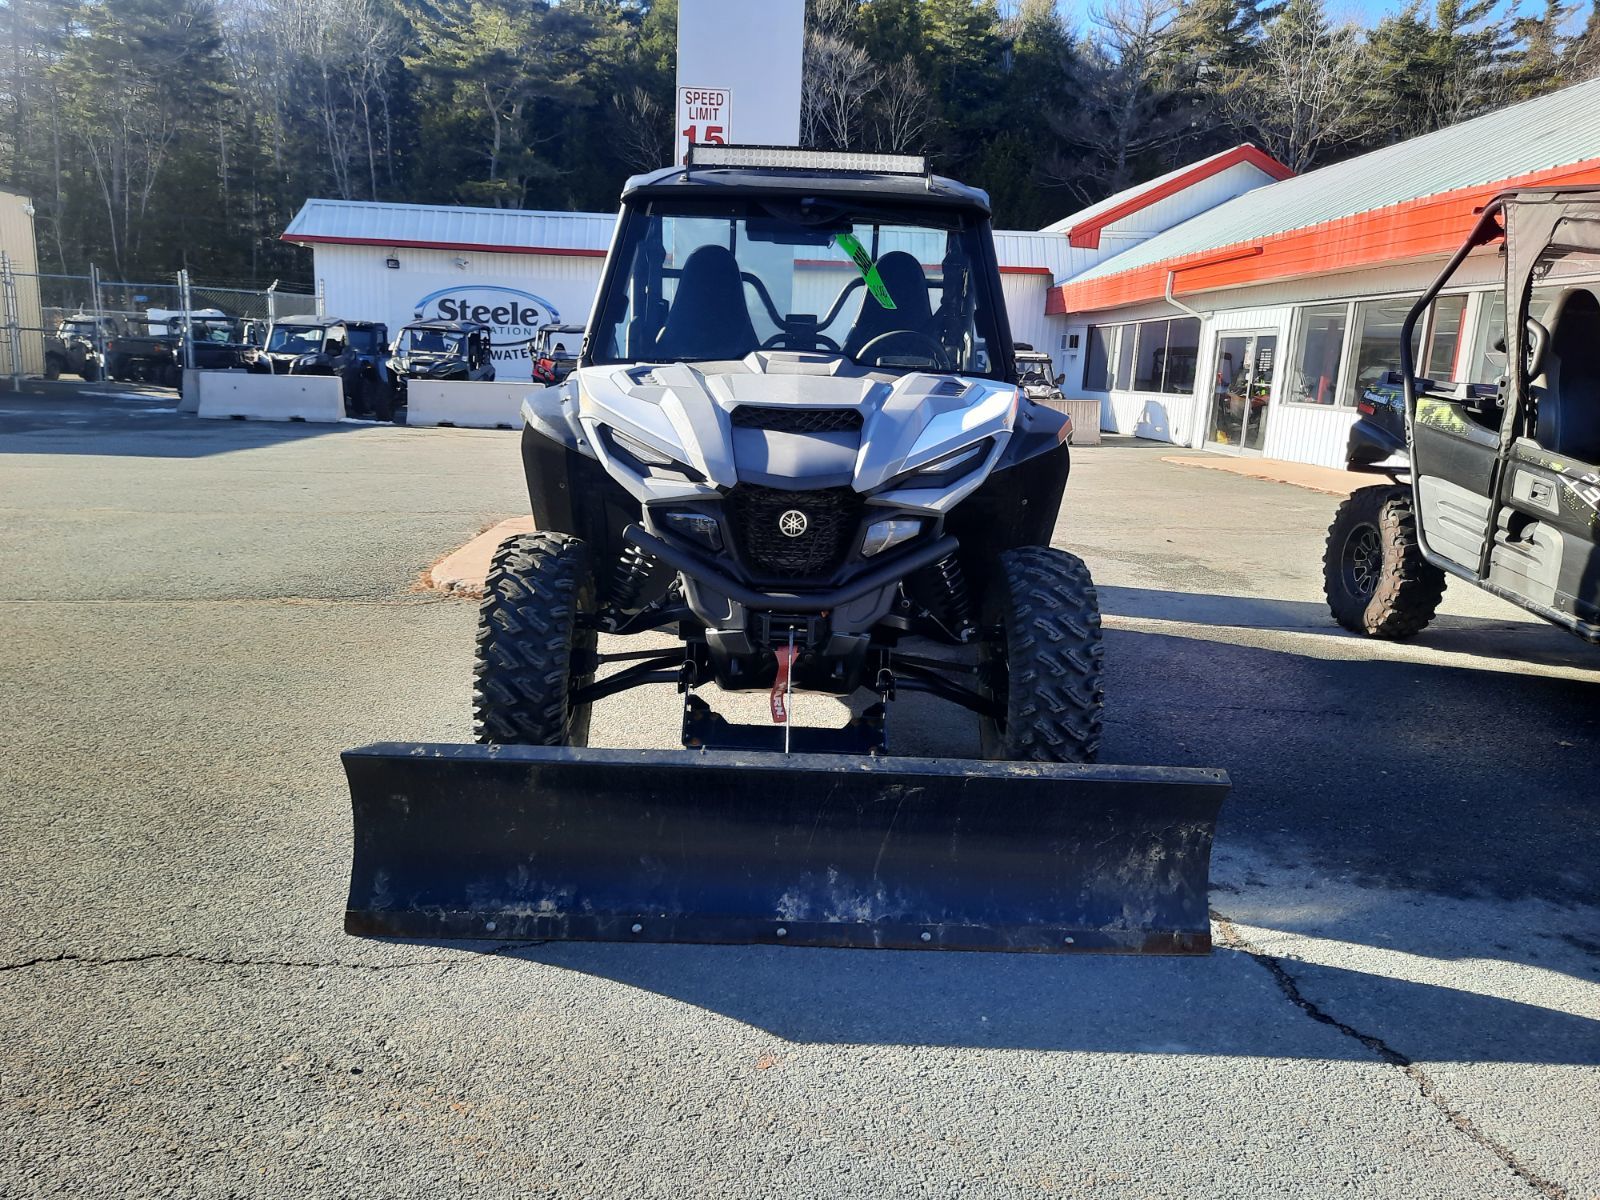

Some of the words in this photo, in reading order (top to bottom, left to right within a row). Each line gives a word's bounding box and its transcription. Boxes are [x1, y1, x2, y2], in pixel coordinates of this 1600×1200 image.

[685, 90, 724, 106] SPEED
[688, 106, 720, 121] LIMIT
[437, 298, 539, 327] Steele
[490, 348, 534, 361] WATE
